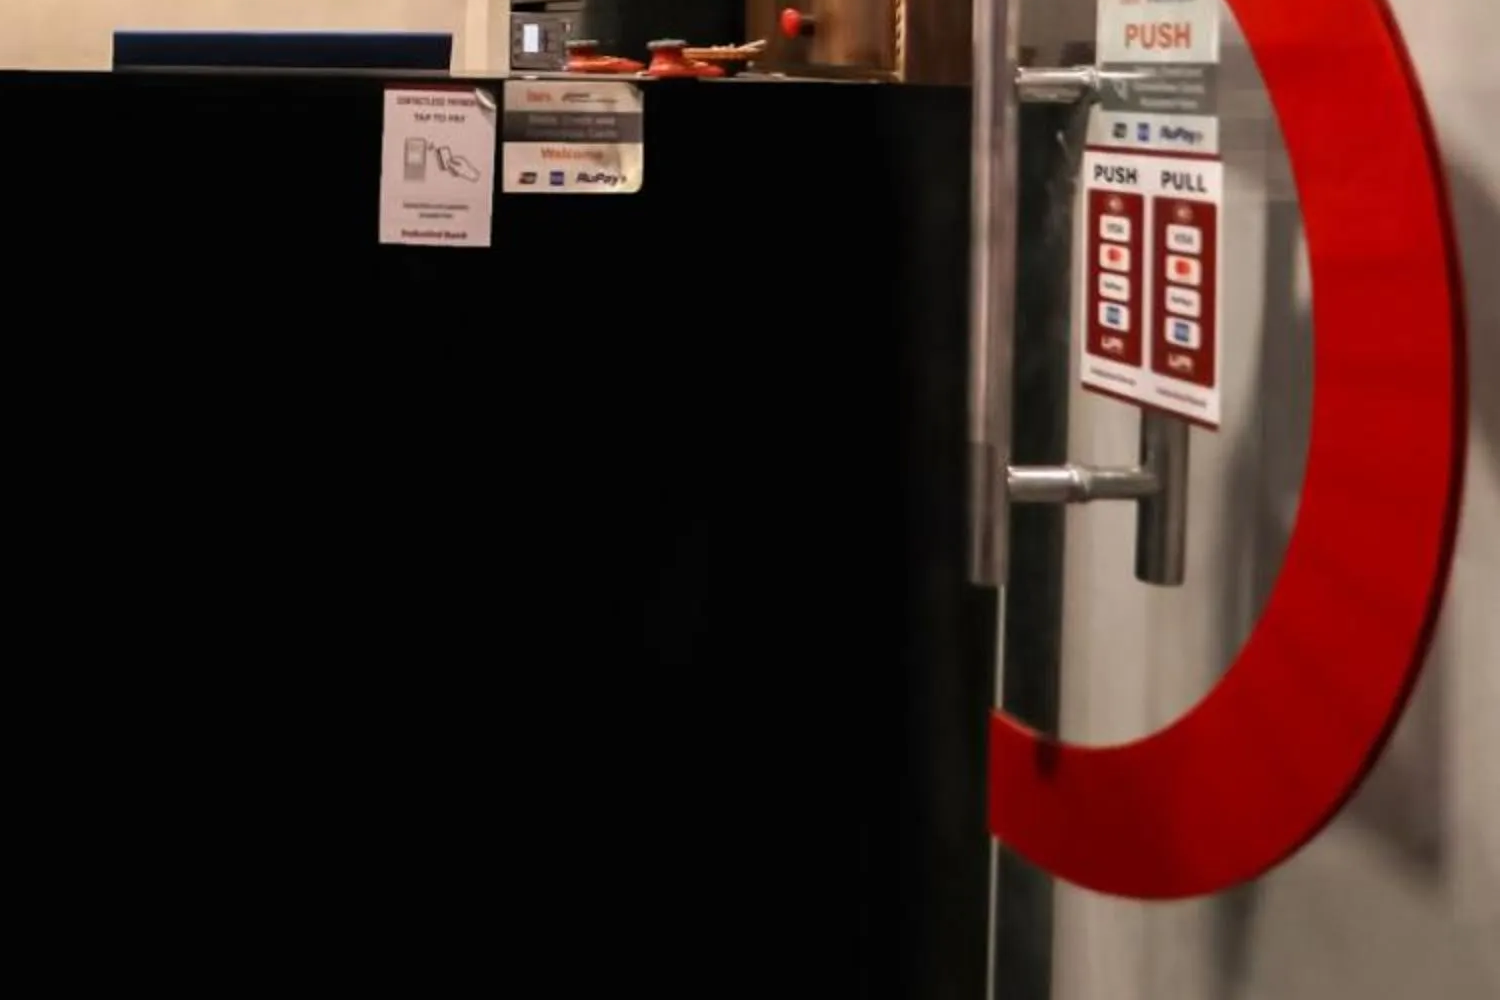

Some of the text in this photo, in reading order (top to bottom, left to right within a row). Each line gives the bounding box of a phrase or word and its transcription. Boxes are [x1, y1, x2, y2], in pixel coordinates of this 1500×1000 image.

[1124, 21, 1192, 50] PUSH
[1093, 163, 1208, 194] PUSH PULL
